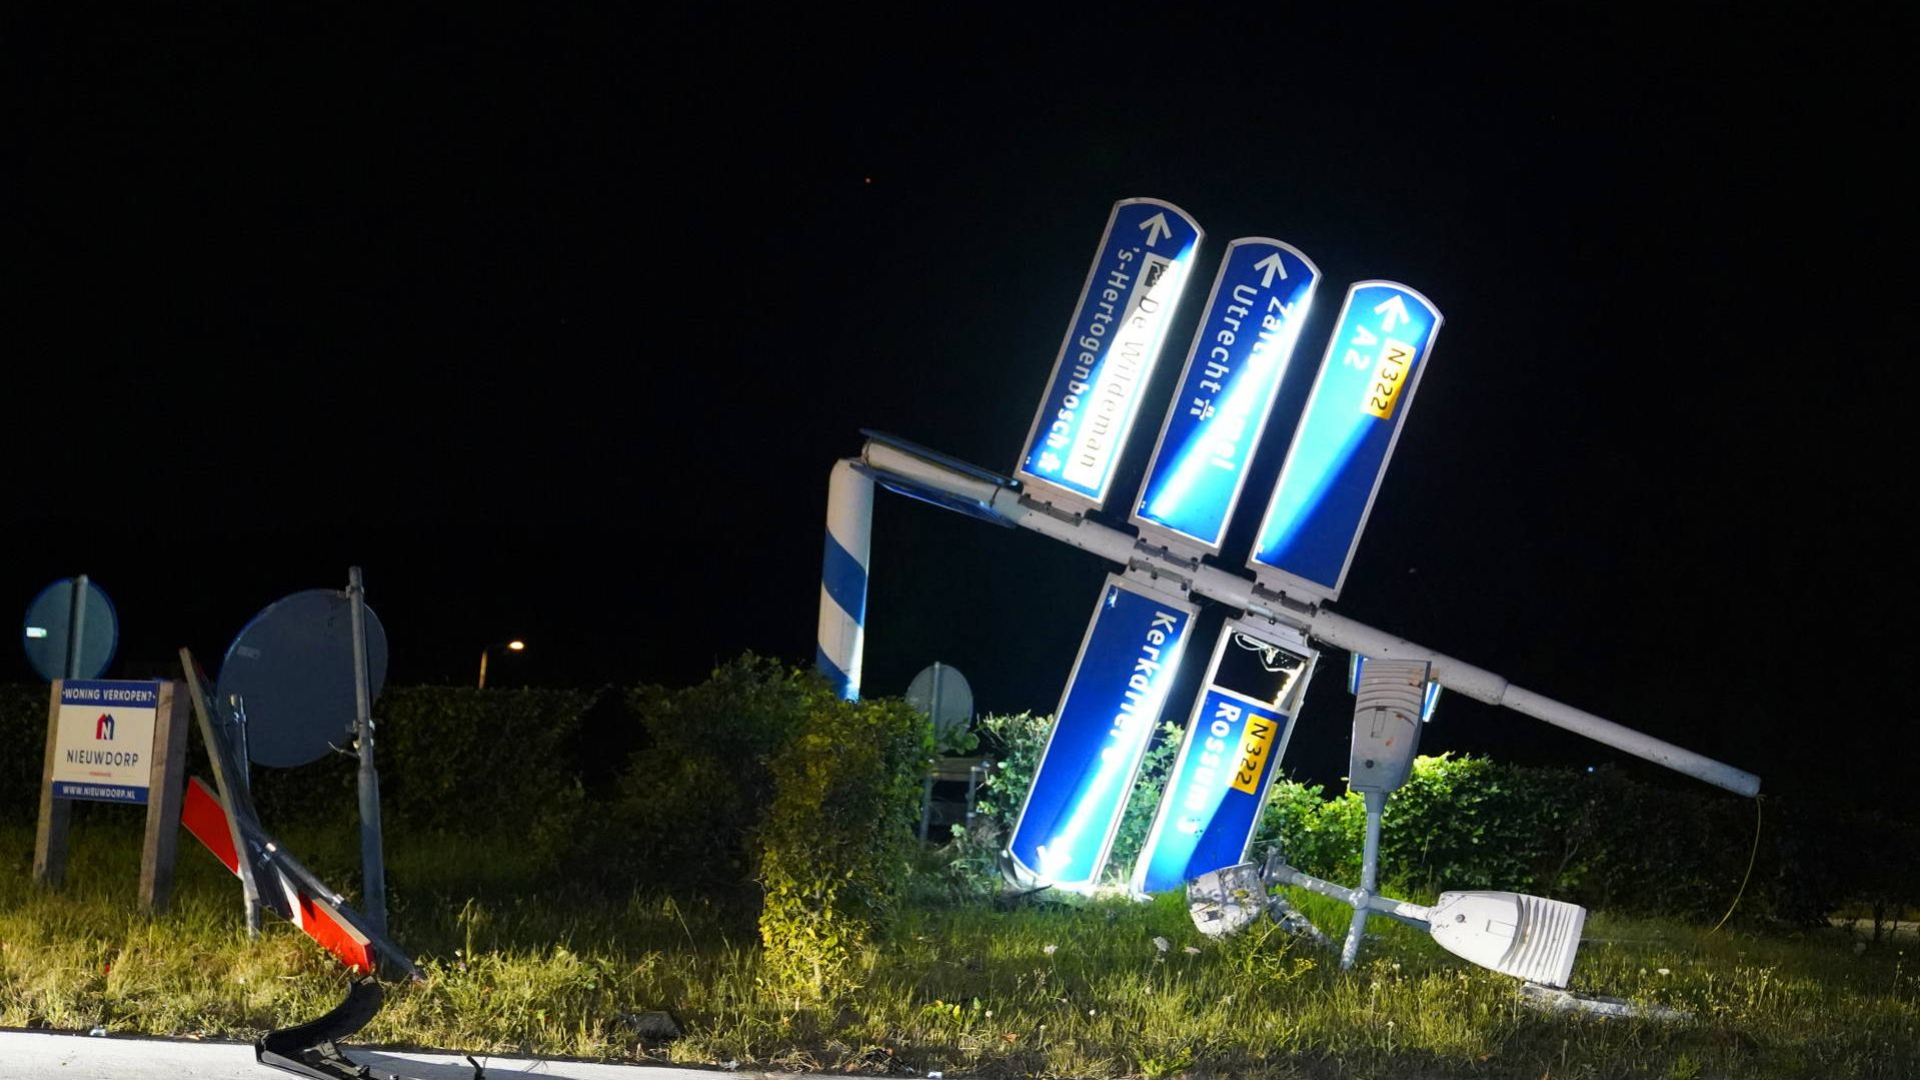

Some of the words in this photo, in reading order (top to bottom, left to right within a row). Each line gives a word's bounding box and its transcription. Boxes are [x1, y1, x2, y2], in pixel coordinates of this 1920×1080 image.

[1132, 295, 1159, 329] De
[1200, 284, 1258, 393] Utrecht
[1046, 247, 1141, 449] 's-Hertogenbosch
[1343, 324, 1378, 370] A2
[1080, 340, 1144, 468] Wildeman
[1370, 348, 1406, 411] N322
[65, 688, 100, 700] WONING
[103, 689, 152, 701] VERKOPEN?
[66, 749, 139, 767] NIEUWDORP
[1184, 701, 1242, 811] Rossum
[1235, 722, 1270, 785] N322
[62, 786, 136, 800] WWW.NIEUWDORP.NL
